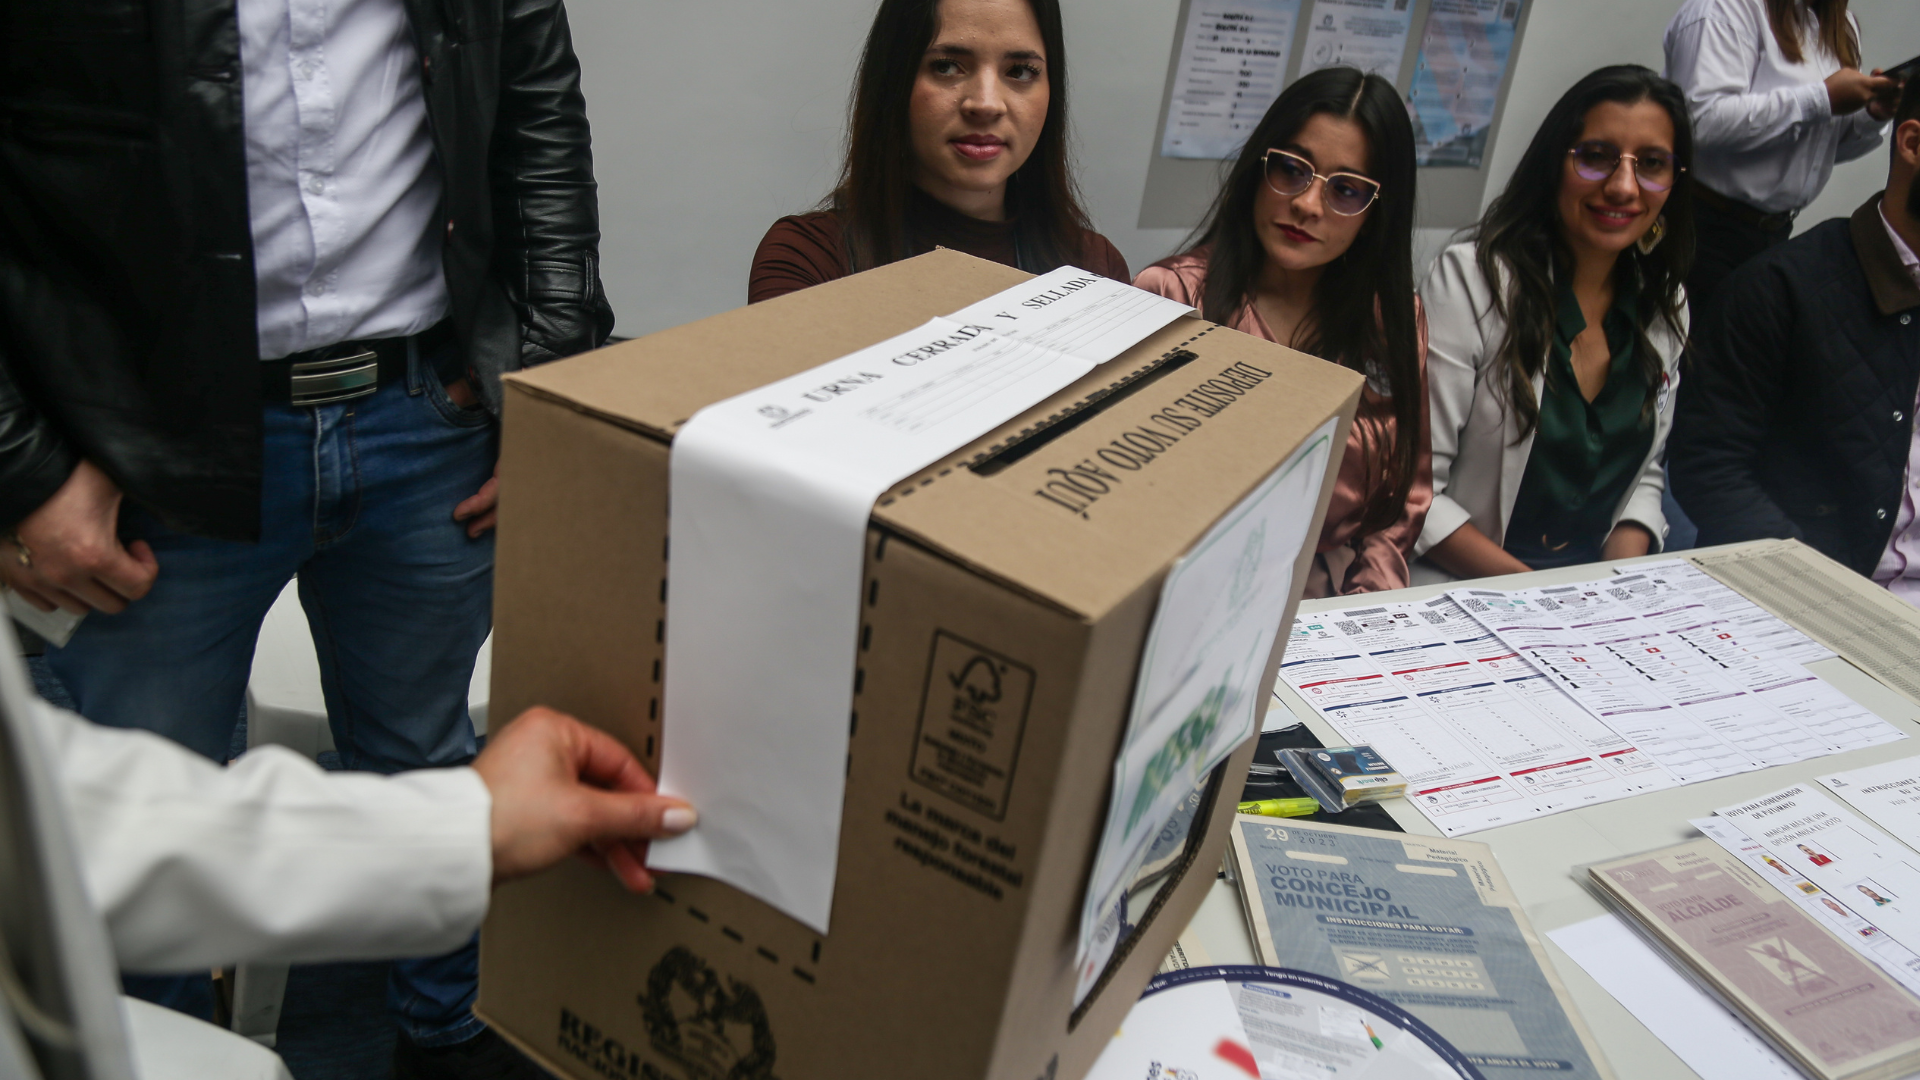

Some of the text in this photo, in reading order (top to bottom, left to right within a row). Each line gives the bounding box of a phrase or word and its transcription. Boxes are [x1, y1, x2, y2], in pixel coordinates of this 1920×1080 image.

[802, 371, 884, 403] URNA
[891, 324, 994, 368] CERRADA
[995, 310, 1019, 321] Y
[1021, 276, 1097, 311] SELLADA
[1034, 361, 1273, 521] DEPOSITE SU VOTO AQUÍ
[1724, 787, 1804, 818] VOTO PARA GOBERNADOR
[898, 790, 1017, 861] La marca del
[1264, 826, 1290, 842] 29
[1303, 831, 1338, 840] OCTUBRE
[885, 810, 1025, 889] manejo forestal
[1429, 847, 1458, 856] Material
[893, 837, 1004, 902] responsable
[1265, 863, 1365, 885] VOTO PARA
[1270, 876, 1392, 902] CONCEJO
[1656, 894, 1706, 911] VOTO PARA
[1274, 891, 1420, 920] MUNICIPAL
[1666, 893, 1745, 923] ALCALDE
[1325, 916, 1465, 935] INSTRUCCIONES PARA VOTAR:
[1264, 969, 1288, 980] Tenga
[1287, 973, 1298, 981] en
[1297, 975, 1324, 987] cuenta
[1486, 1057, 1518, 1067] ANULA
[1519, 1059, 1531, 1068] EL
[1533, 1060, 1560, 1069] VOTO
